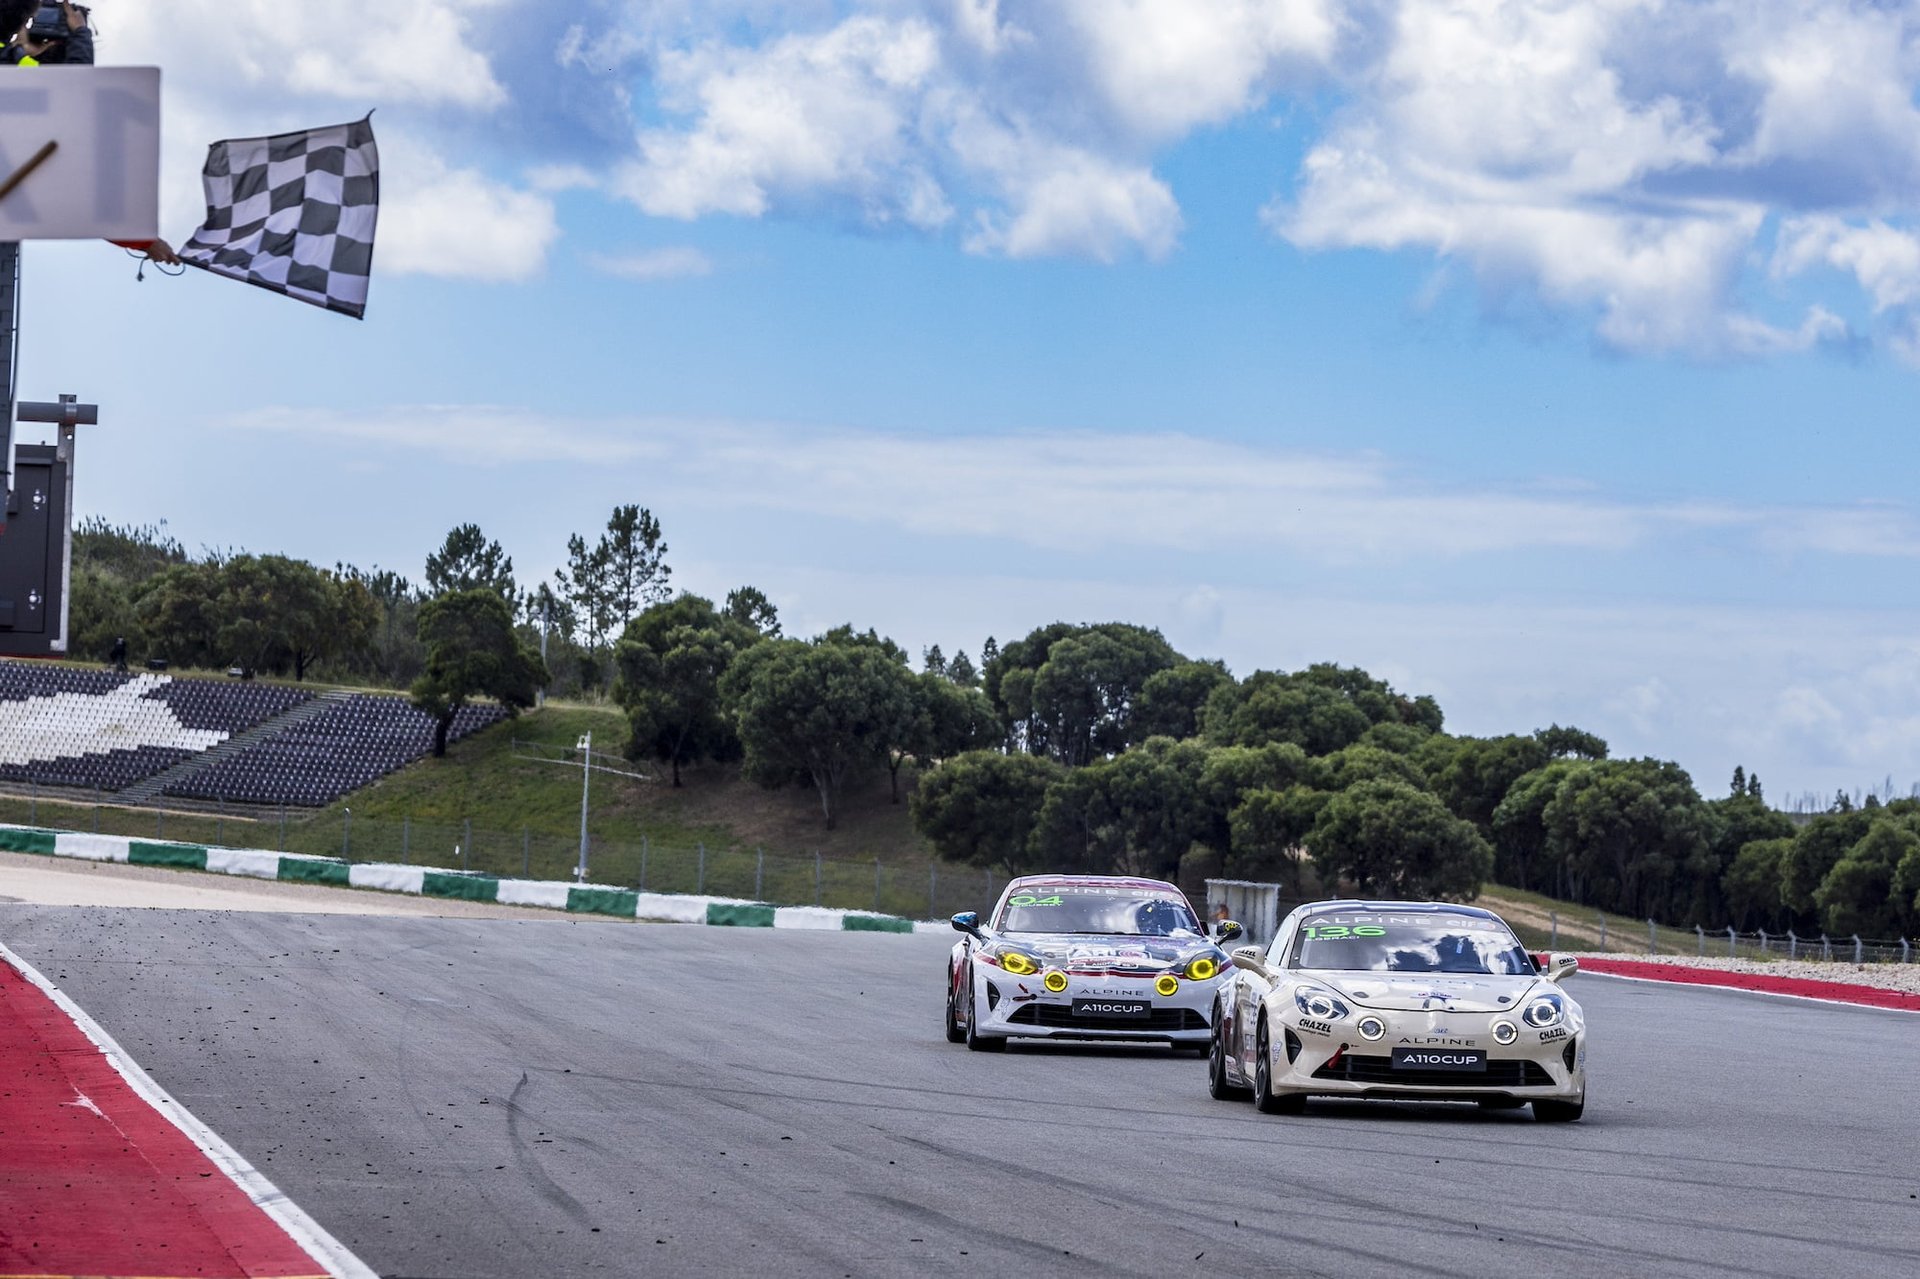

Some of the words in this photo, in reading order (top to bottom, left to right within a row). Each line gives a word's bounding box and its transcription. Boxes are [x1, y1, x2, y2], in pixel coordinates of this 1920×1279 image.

[1018, 886, 1120, 895] ALPINE
[1009, 895, 1064, 905] 04
[1311, 915, 1432, 925] ALPINE
[1302, 925, 1387, 938] 136
[1079, 988, 1144, 997] ALPINE
[1081, 1003, 1144, 1013] A110CUP
[1298, 1018, 1332, 1033] CHAZEL
[1539, 1027, 1567, 1041] CHAZEL
[1398, 1037, 1476, 1047] ALPINE
[1402, 1054, 1478, 1065] A110CUP
